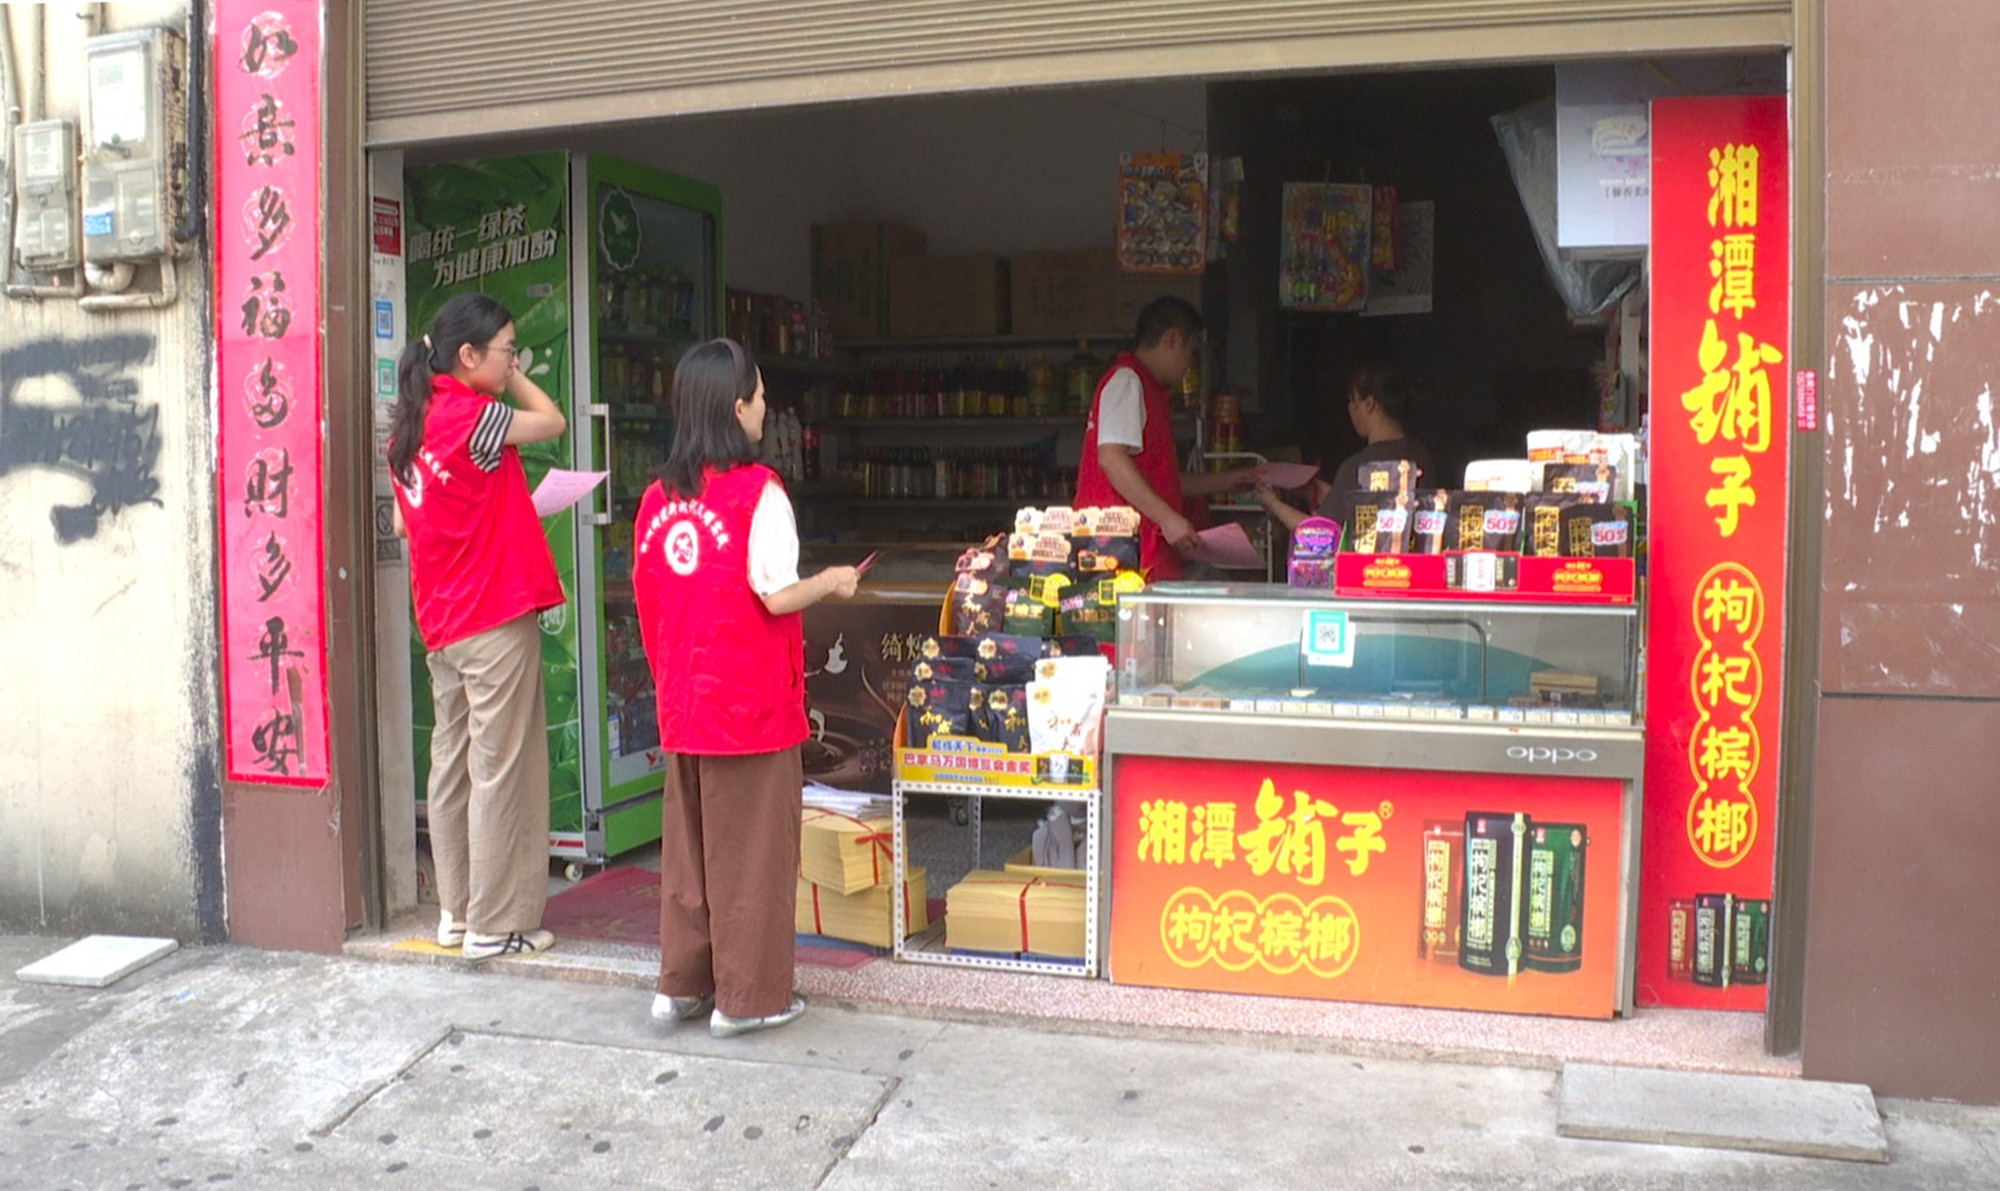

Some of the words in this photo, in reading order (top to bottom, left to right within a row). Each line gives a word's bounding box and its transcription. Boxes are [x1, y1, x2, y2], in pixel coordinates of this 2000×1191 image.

[409, 203, 527, 264] 喝统一绿茶
[432, 228, 558, 289] 为健康加酚
[1681, 142, 1783, 538] 湘潭铺子
[1695, 577, 1755, 855] 枸杞槟榔
[1137, 777, 1387, 885] 湘潭铺子
[1168, 902, 1352, 964] 枸杞槟榔
